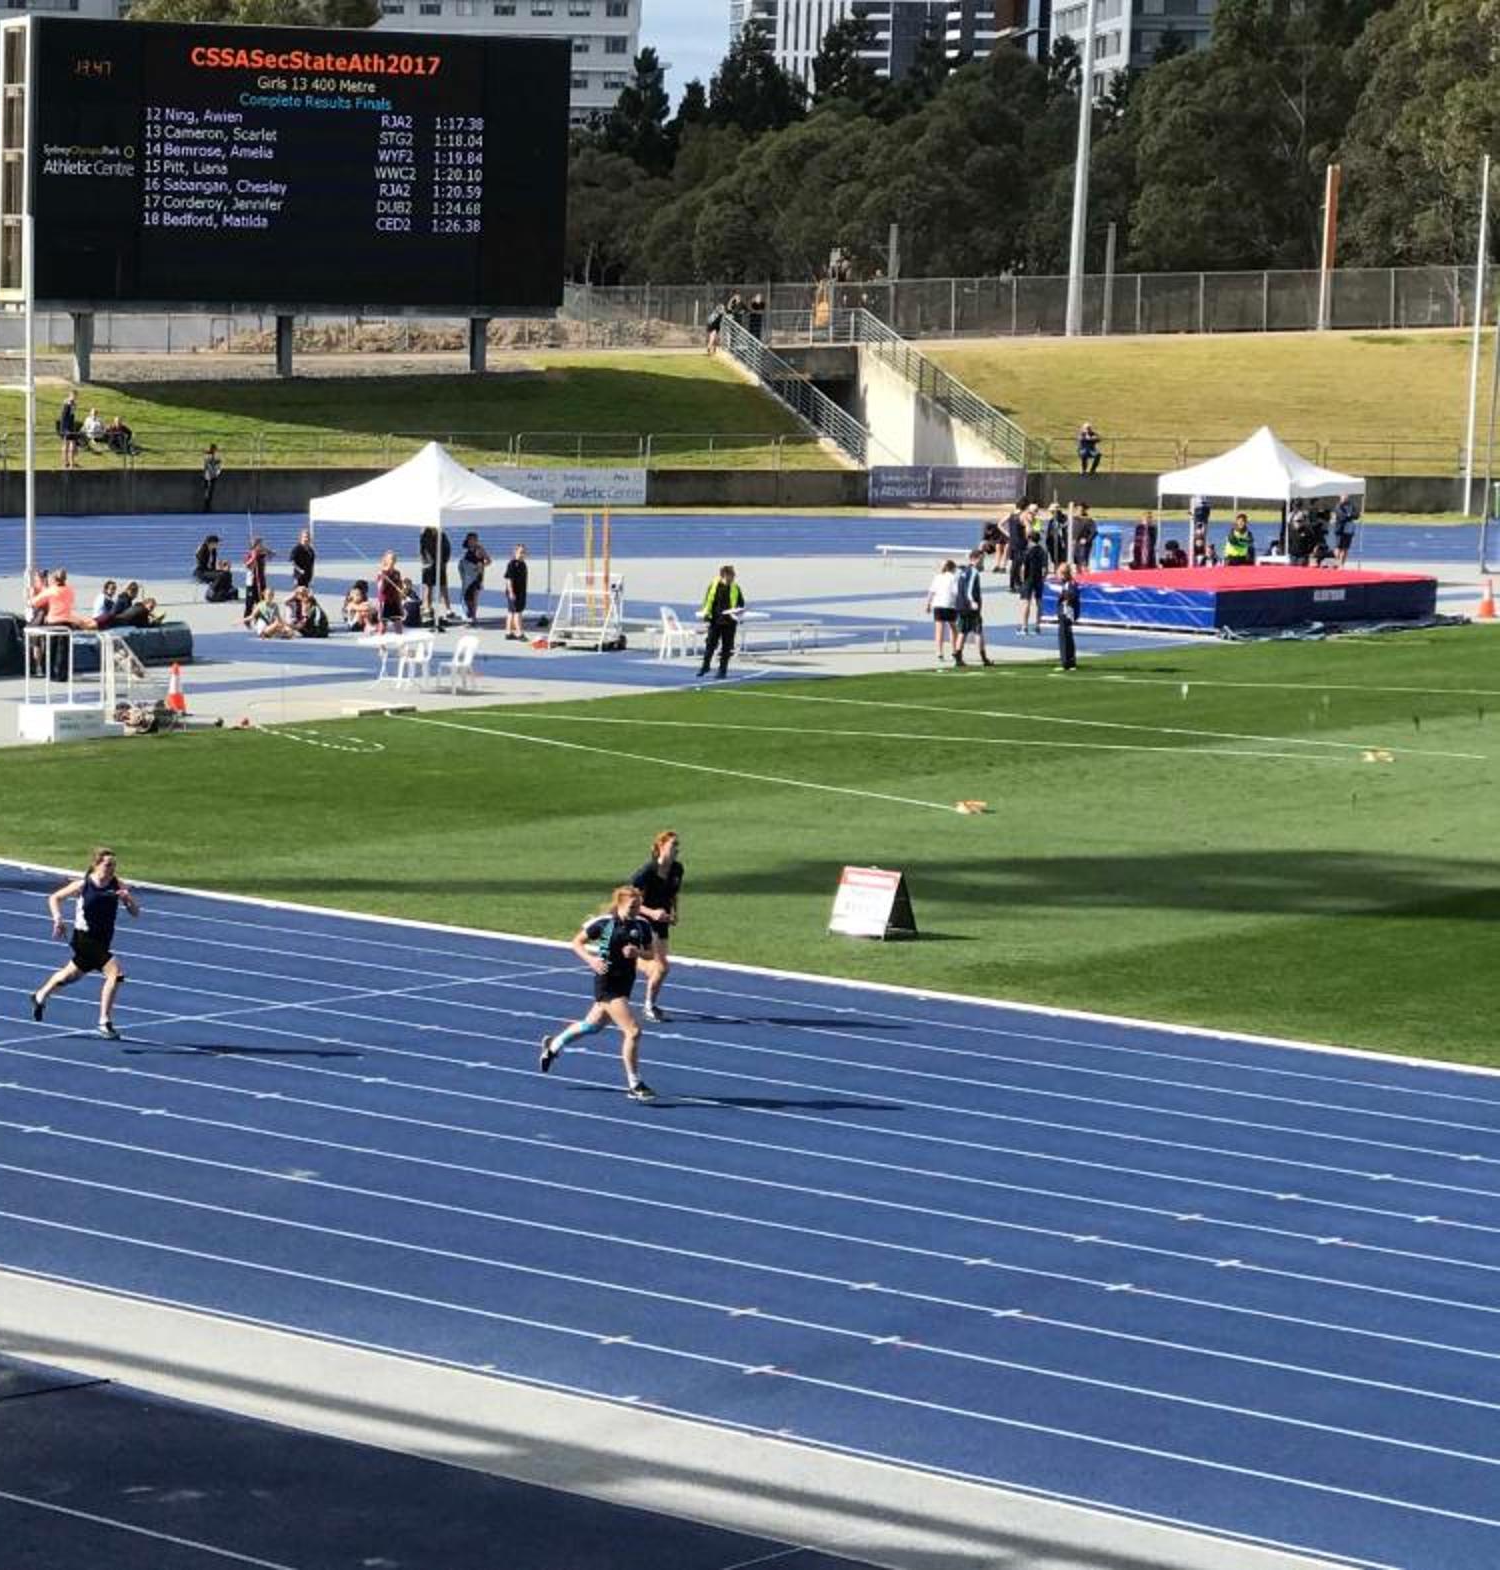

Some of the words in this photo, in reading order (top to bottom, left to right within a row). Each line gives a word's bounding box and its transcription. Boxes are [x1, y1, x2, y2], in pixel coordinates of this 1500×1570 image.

[191, 47, 442, 75] CSSASecStateAth2017
[257, 76, 288, 91] Girls
[291, 77, 308, 91] 13
[311, 78, 336, 92] 400
[339, 79, 377, 94] Metre
[239, 92, 302, 109] Complete
[305, 95, 351, 110] Results
[355, 97, 393, 111] Finals
[145, 107, 161, 121] 12
[381, 115, 413, 129] RJA2
[145, 125, 161, 139] 13
[164, 125, 228, 142] Cameron,
[380, 132, 414, 146] STG2
[435, 134, 483, 147] 1:18.04
[145, 142, 161, 156] 14
[163, 143, 226, 160] Bemrose,
[230, 145, 274, 159] Amelia
[378, 149, 414, 163] WYF2
[434, 151, 483, 165] 1:19.84
[144, 159, 161, 173] 15
[163, 160, 189, 176] Pitt,
[374, 167, 417, 181] WWC2
[434, 168, 483, 181] 1:20.10
[144, 177, 161, 191] 16
[380, 183, 411, 197] RJA2
[433, 185, 482, 199] 1:20.59
[144, 195, 160, 208] 17
[162, 195, 228, 211] Corderoy,
[232, 197, 283, 211] Jennifer
[432, 202, 481, 215] 1:24.68
[143, 212, 159, 225] 18
[163, 212, 218, 229] Bedford,
[222, 214, 269, 227] Matilda
[376, 218, 411, 231] CED2
[432, 219, 481, 233] 1:26.38
